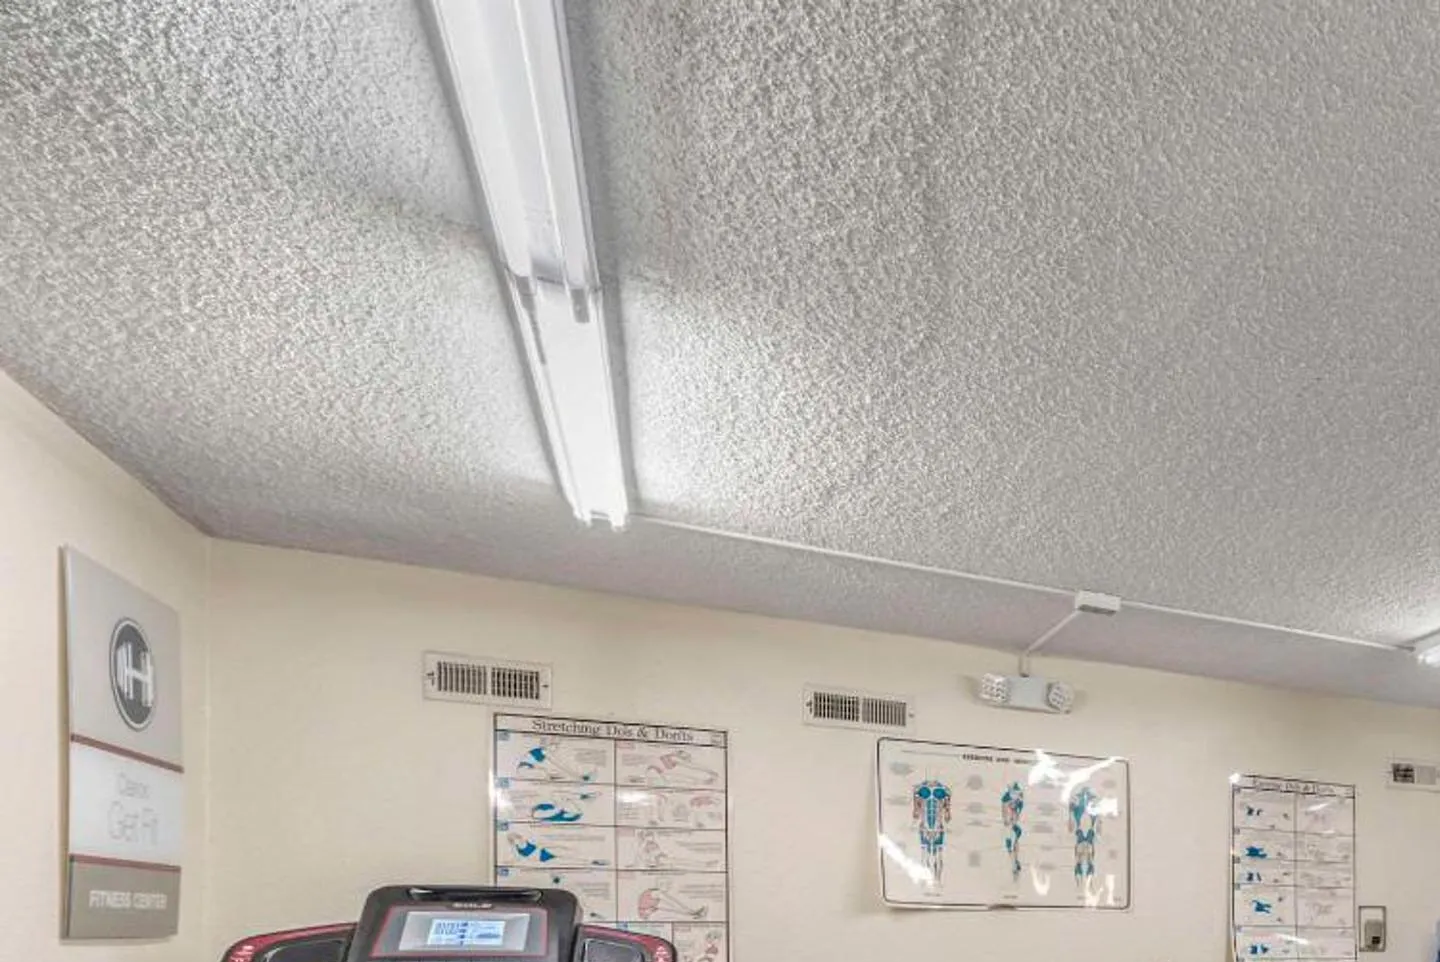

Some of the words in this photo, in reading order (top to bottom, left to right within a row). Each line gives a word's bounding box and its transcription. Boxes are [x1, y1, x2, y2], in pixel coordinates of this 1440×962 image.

[531, 718, 600, 736] Stretching
[636, 727, 649, 739] &
[88, 889, 132, 909] FITNESS
